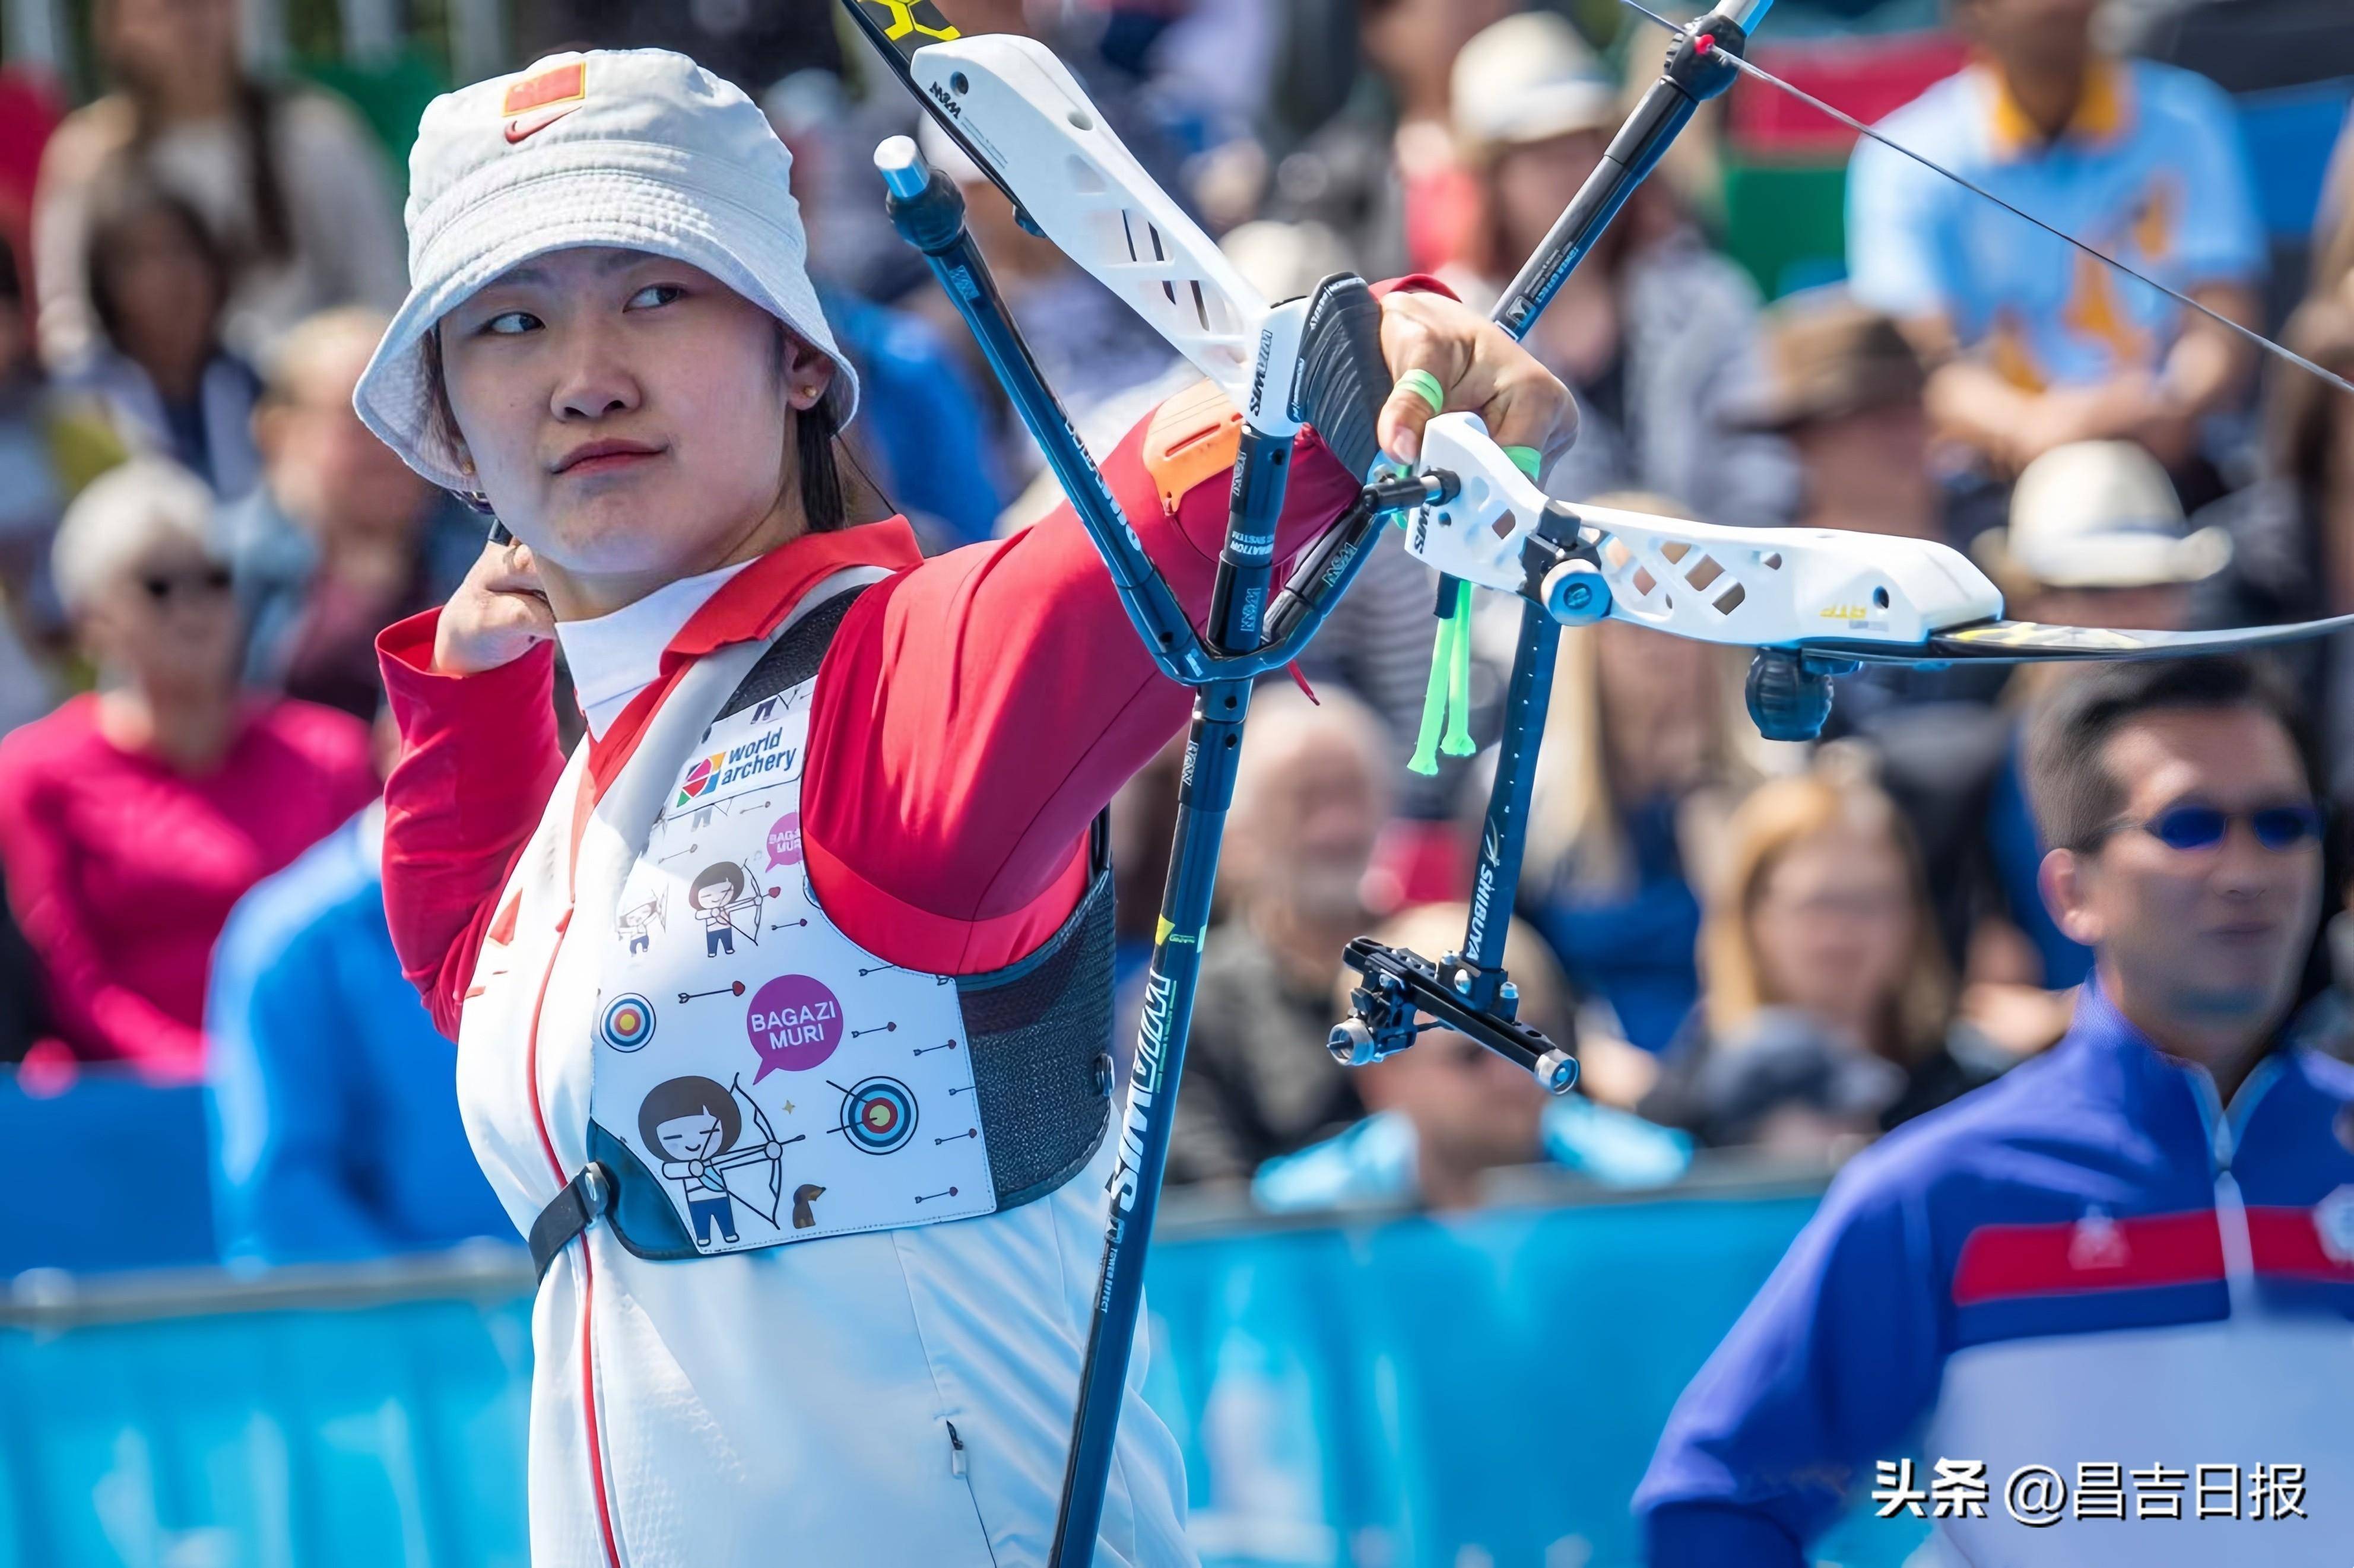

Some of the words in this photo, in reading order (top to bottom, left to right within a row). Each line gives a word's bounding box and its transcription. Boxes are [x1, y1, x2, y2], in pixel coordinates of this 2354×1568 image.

[728, 726, 783, 764] world
[721, 747, 797, 785] archery
[1466, 864, 1495, 961] SHIBUYA
[751, 1001, 836, 1032] BAGAZI
[769, 1023, 824, 1049] MURI
[1112, 967, 1171, 1212] WIAWIS
